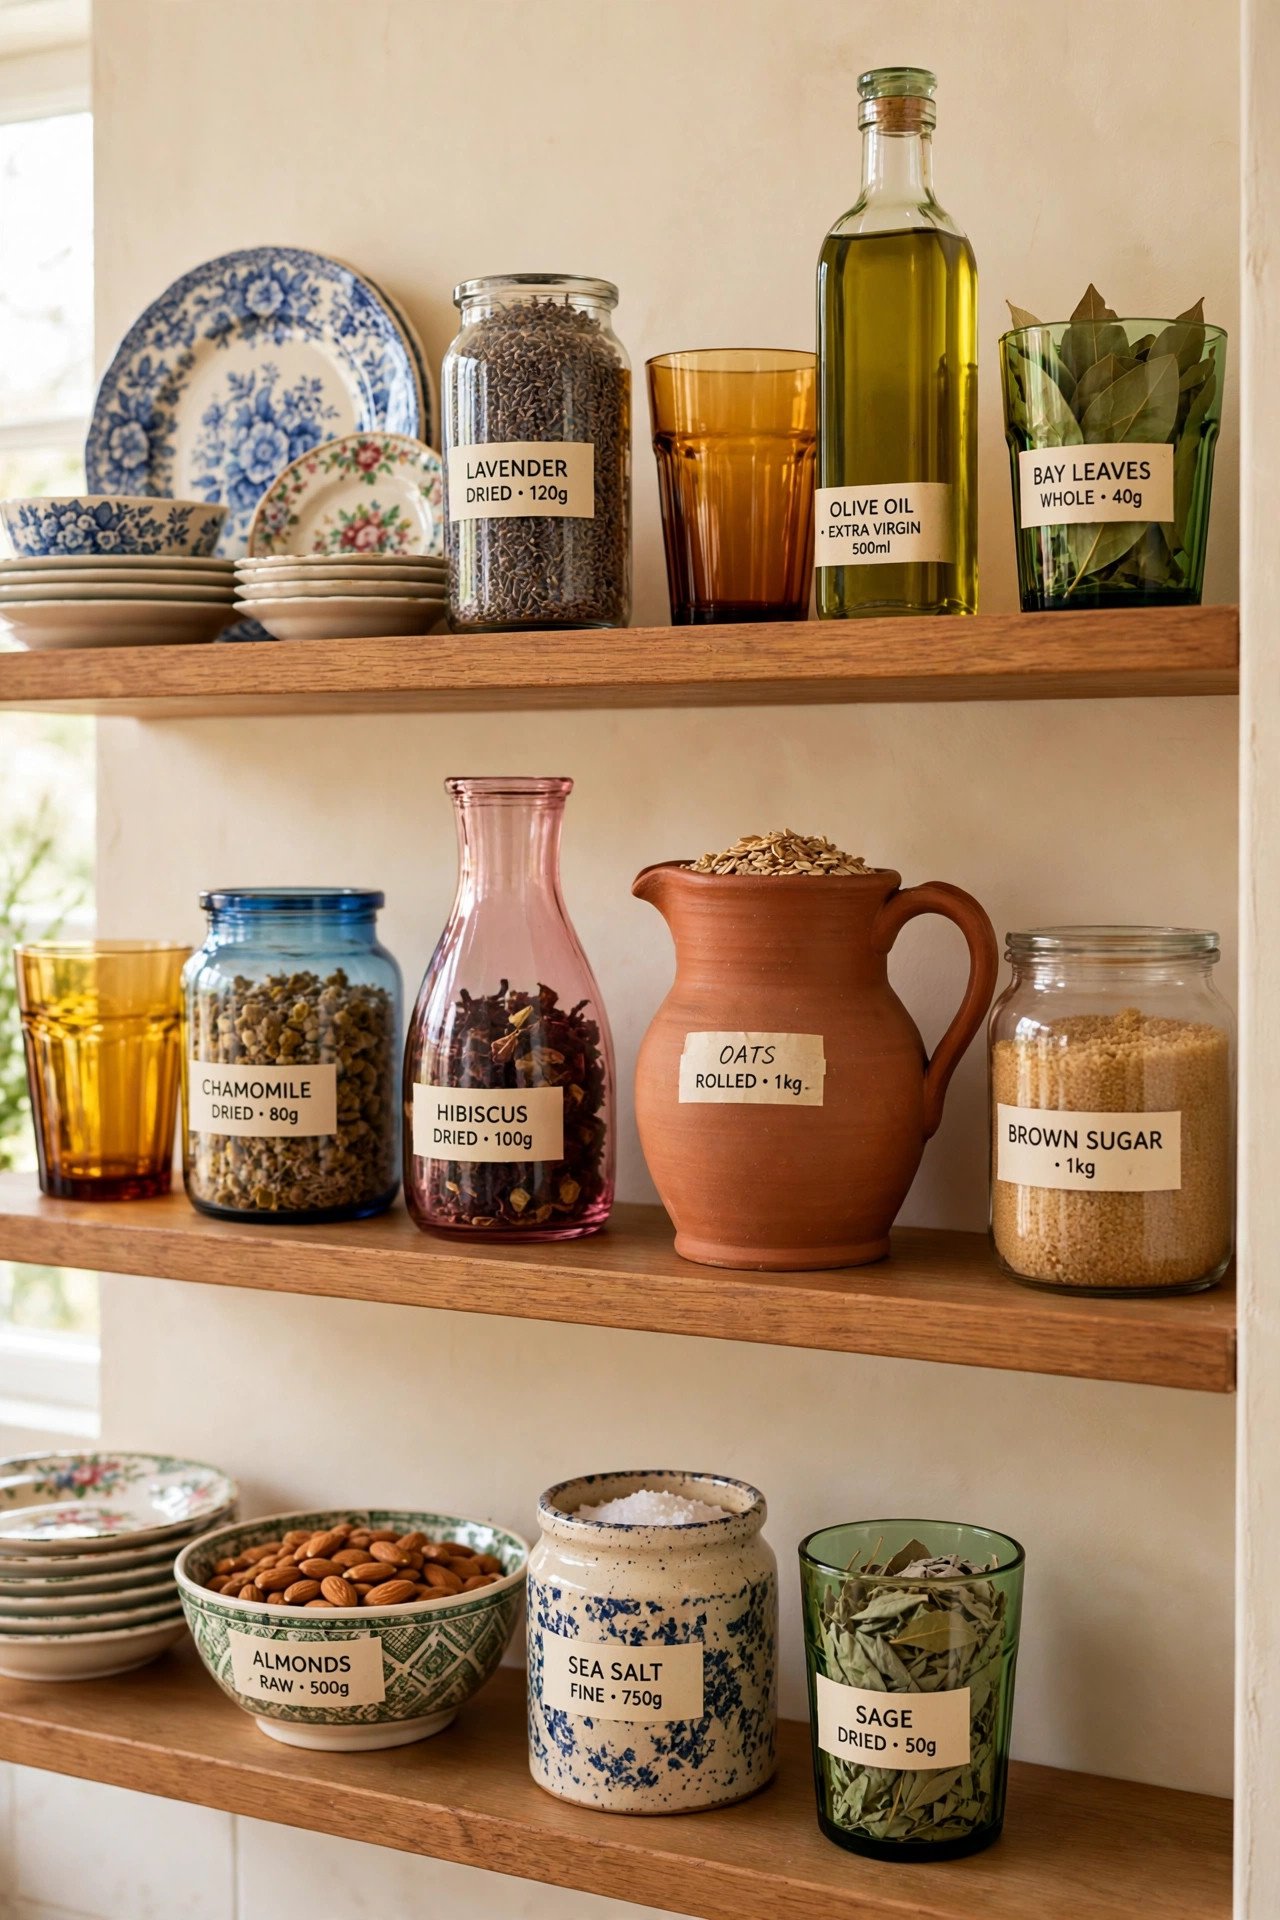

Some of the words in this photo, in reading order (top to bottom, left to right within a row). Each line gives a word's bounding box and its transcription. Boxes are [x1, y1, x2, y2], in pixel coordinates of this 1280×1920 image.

[466, 458, 569, 480] LAVENDER
[1033, 464, 1066, 486] BAY
[1072, 460, 1152, 482] LEAVES
[466, 485, 513, 503] DRIED
[529, 484, 568, 506] 120g
[1039, 489, 1095, 508] WHOLE
[1111, 488, 1143, 509] 40g
[829, 499, 879, 518] OLIVE
[883, 497, 915, 515] OIL
[828, 523, 870, 539] EXTRA
[872, 520, 921, 536] VIRGIN
[852, 539, 891, 556] 500ml
[719, 1044, 777, 1065] OATS
[203, 1078, 313, 1101] CHAMOMILE
[695, 1072, 758, 1089] ROLLED
[212, 1104, 254, 1121] DRIED
[269, 1106, 299, 1126] 80g
[437, 1103, 529, 1124] HIBISCUS
[433, 1127, 479, 1146] DRIED
[494, 1130, 533, 1151] 100g
[1008, 1123, 1079, 1150] BROWN
[1086, 1130, 1163, 1151] SUGAR
[1066, 1157, 1096, 1180] 1kg
[252, 1650, 352, 1674] ALMONDS
[568, 1655, 605, 1680] SEA
[610, 1661, 664, 1682] SALT
[259, 1674, 294, 1694] RAW
[310, 1680, 350, 1698] 500g
[570, 1682, 605, 1704] FINE
[621, 1689, 663, 1711] 750g
[855, 1705, 913, 1729] SAGE
[838, 1725, 887, 1752] DRIED
[905, 1737, 937, 1758] 50g
